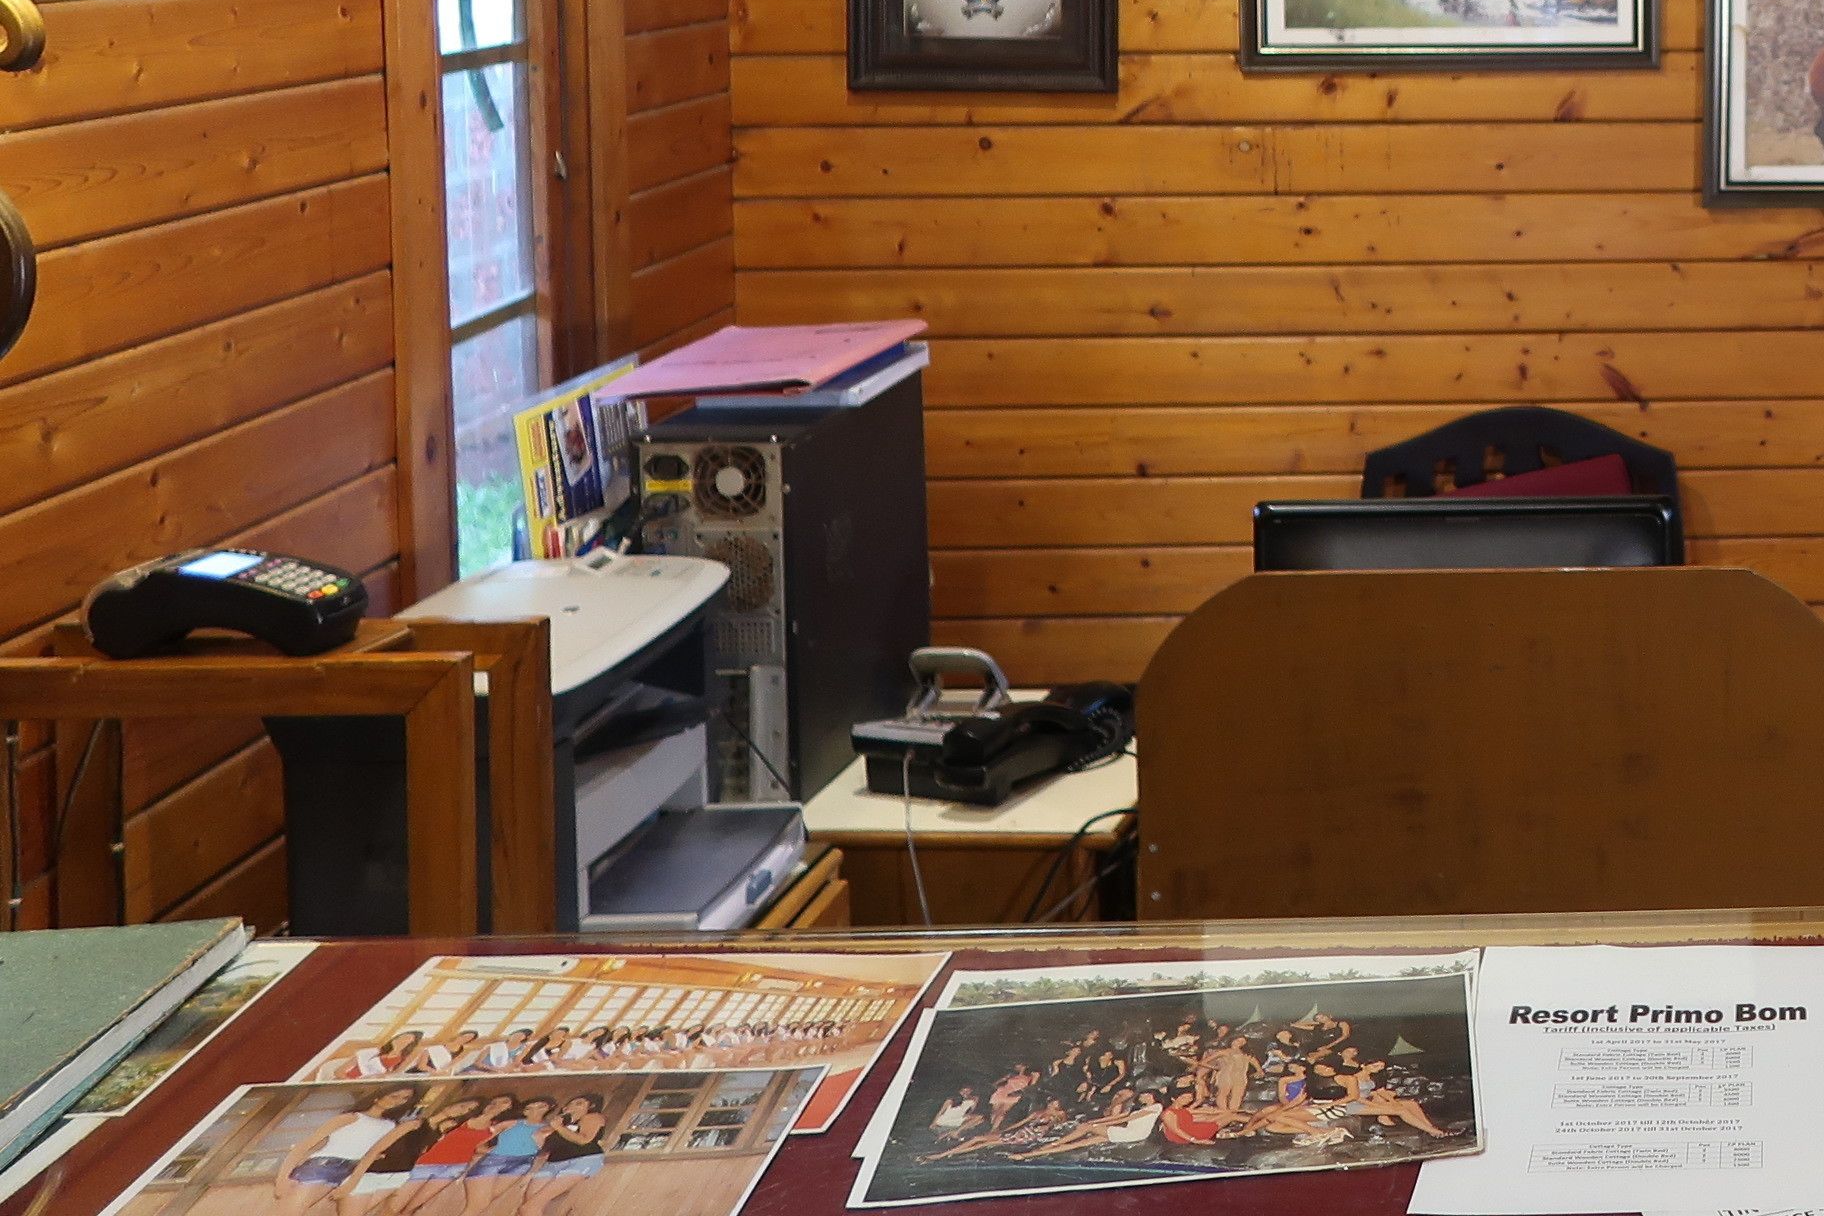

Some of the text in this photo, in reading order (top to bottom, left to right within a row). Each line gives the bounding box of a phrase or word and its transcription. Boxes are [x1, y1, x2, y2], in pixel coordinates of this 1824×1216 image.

[1508, 1003, 1808, 1025] Resort Primo Bom
[1543, 1024, 1776, 1034] Tariff (Inclusive of applicable Taxes)
